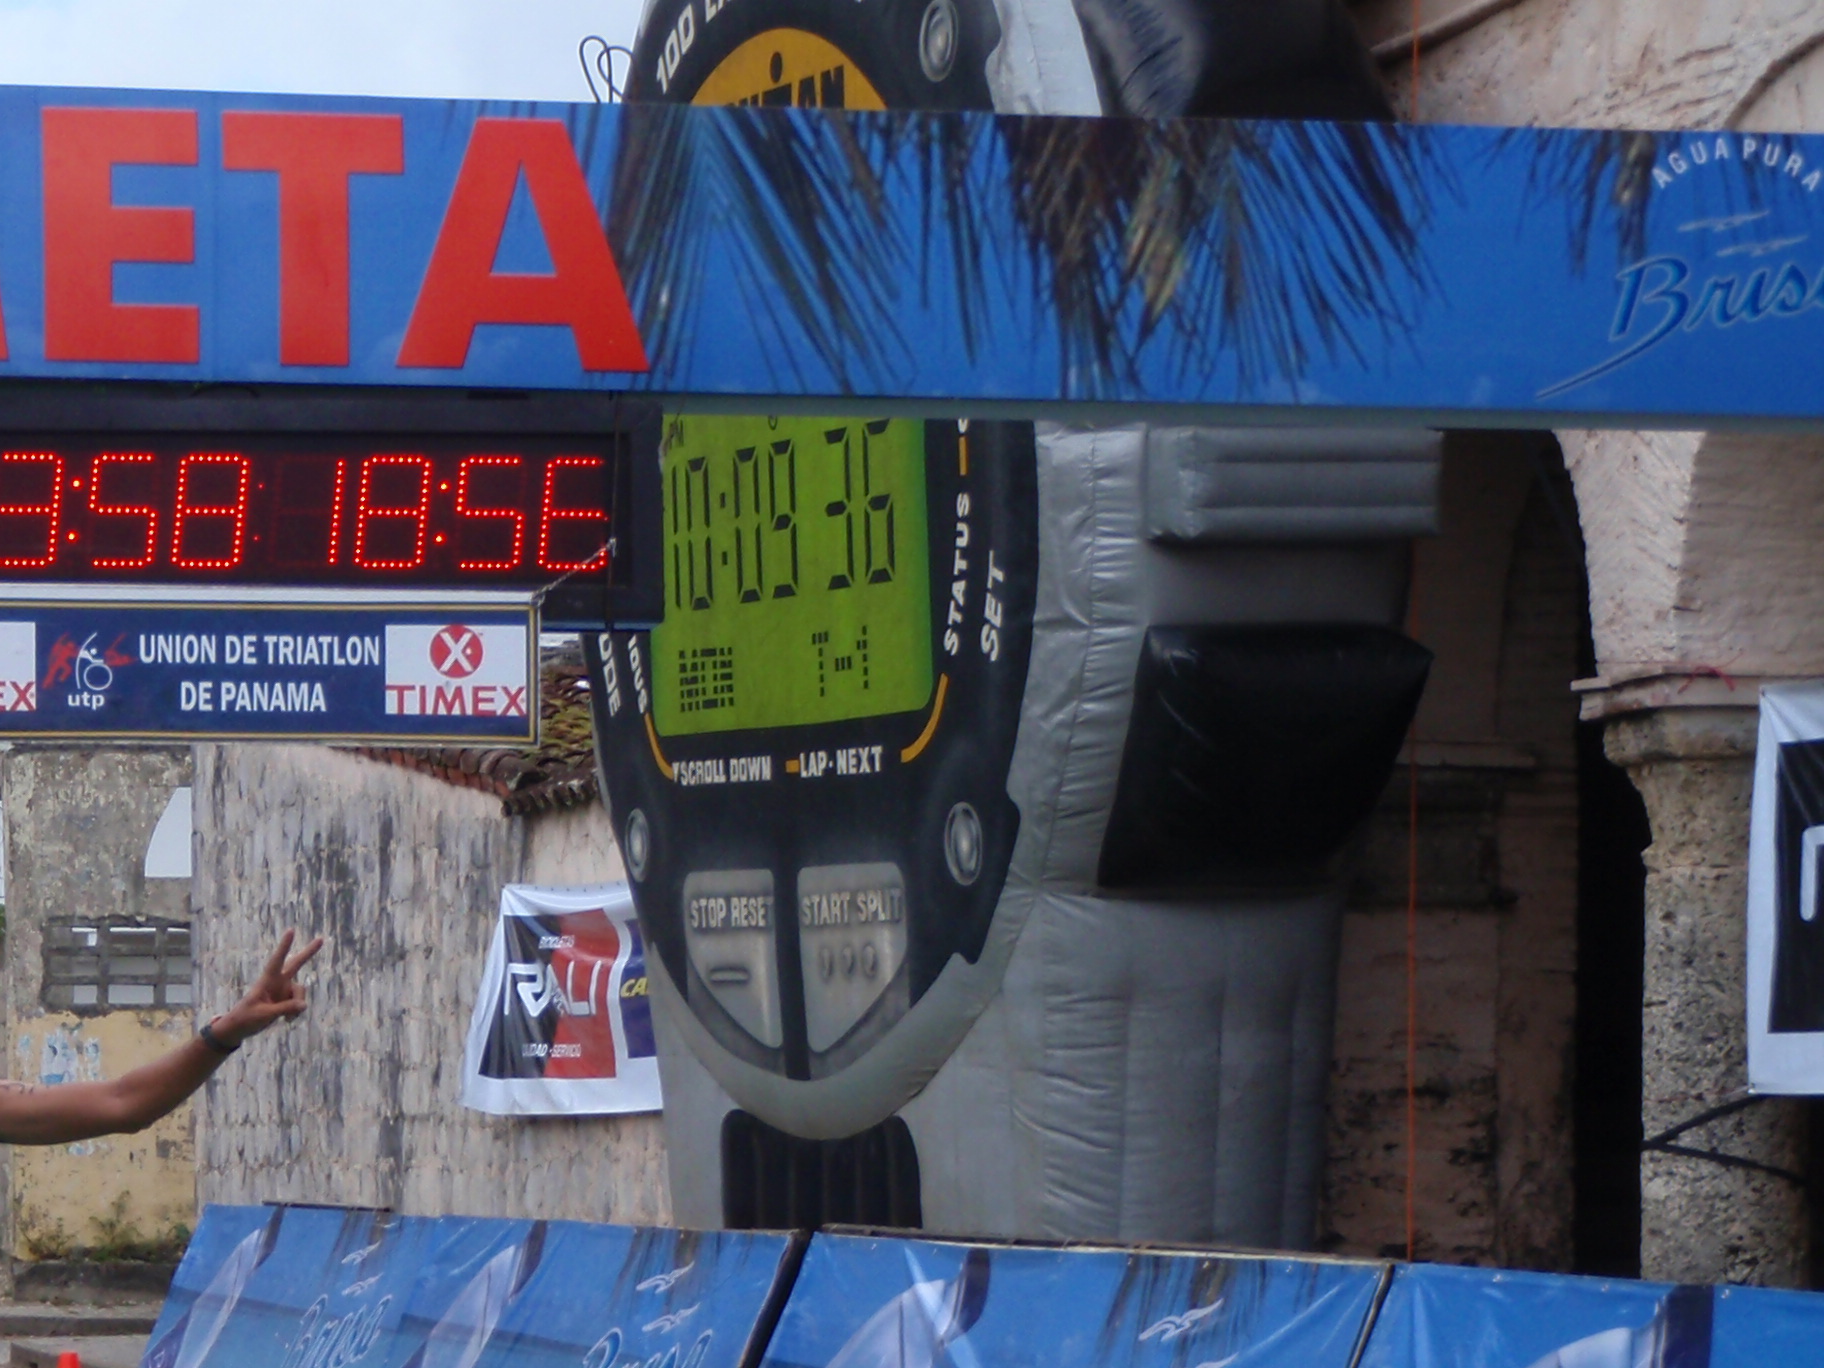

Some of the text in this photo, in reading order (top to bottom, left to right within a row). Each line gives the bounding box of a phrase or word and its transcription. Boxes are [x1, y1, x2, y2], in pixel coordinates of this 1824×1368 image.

[656, 3, 695, 95] 100
[1651, 137, 1822, 192] AGUA PURA
[943, 491, 971, 656] STATUS
[981, 549, 1005, 662] SET
[139, 634, 380, 667] UNION DE TRIATLON
[67, 694, 106, 710] utp
[180, 682, 327, 713] DE PANAMA
[385, 684, 528, 717] TIMEX
[680, 755, 772, 786] SCROLL DOWN
[690, 896, 773, 928] STOP RESET
[802, 887, 902, 926] START SPLIT
[503, 959, 602, 1018] RALI
[620, 977, 650, 998] CA
